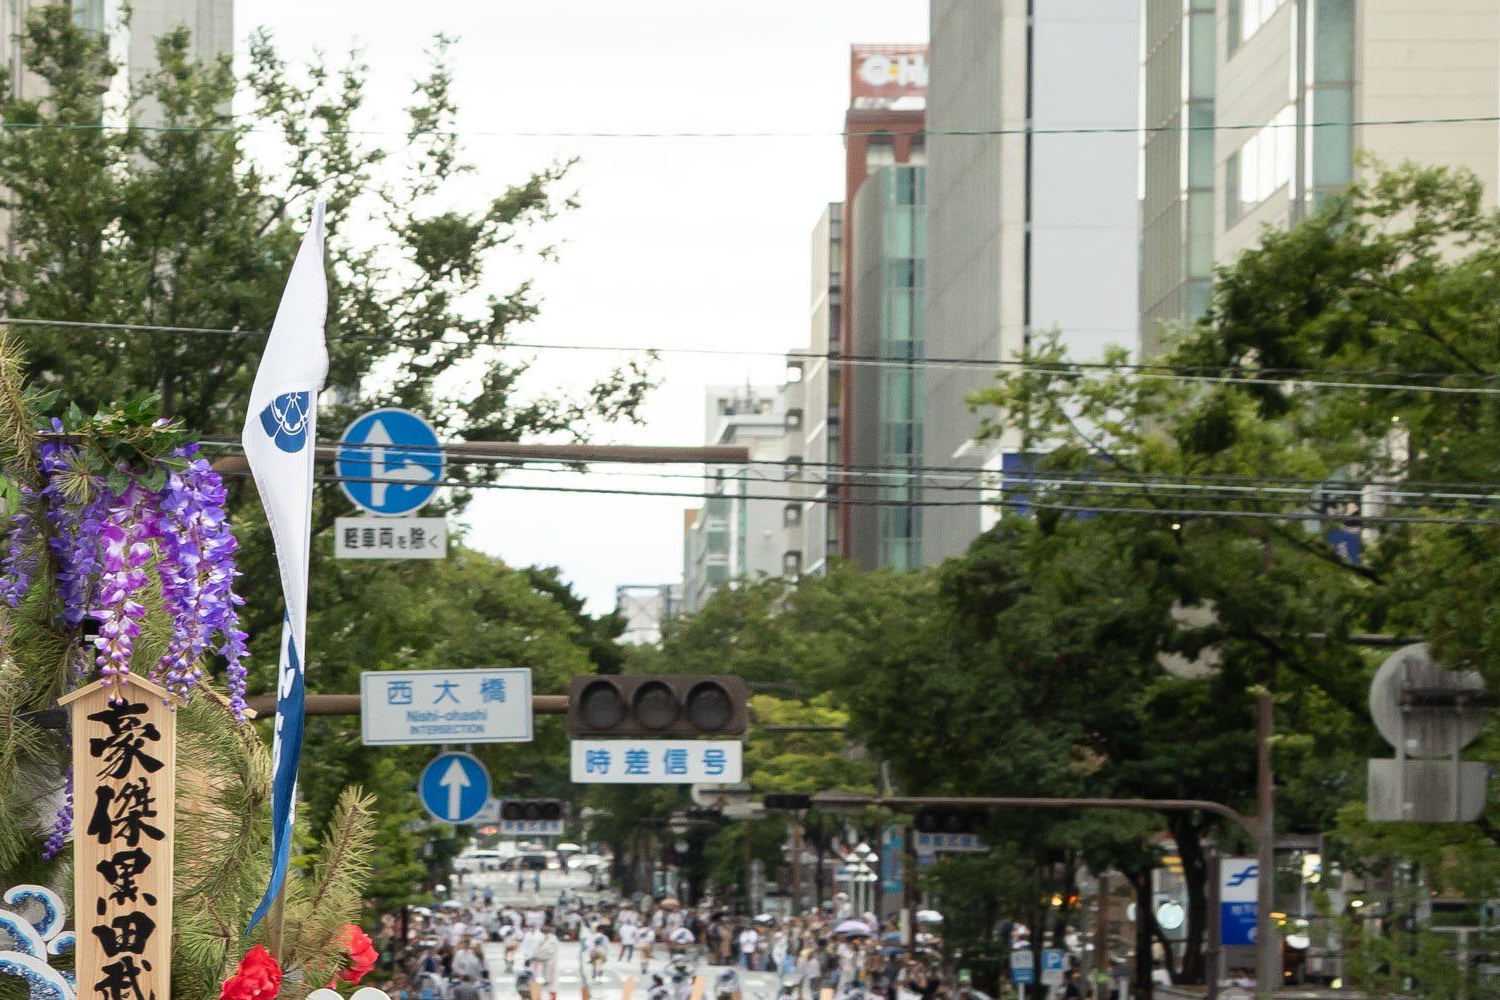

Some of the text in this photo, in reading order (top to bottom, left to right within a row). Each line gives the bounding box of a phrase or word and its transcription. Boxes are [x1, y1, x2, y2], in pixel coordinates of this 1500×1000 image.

[344, 527, 439, 549] 軽車両を除く
[386, 677, 507, 705] 西大橋
[406, 709, 488, 723] Nishi-ohashi
[409, 723, 485, 735] INTERSECTION
[585, 748, 727, 775] 時差信号
